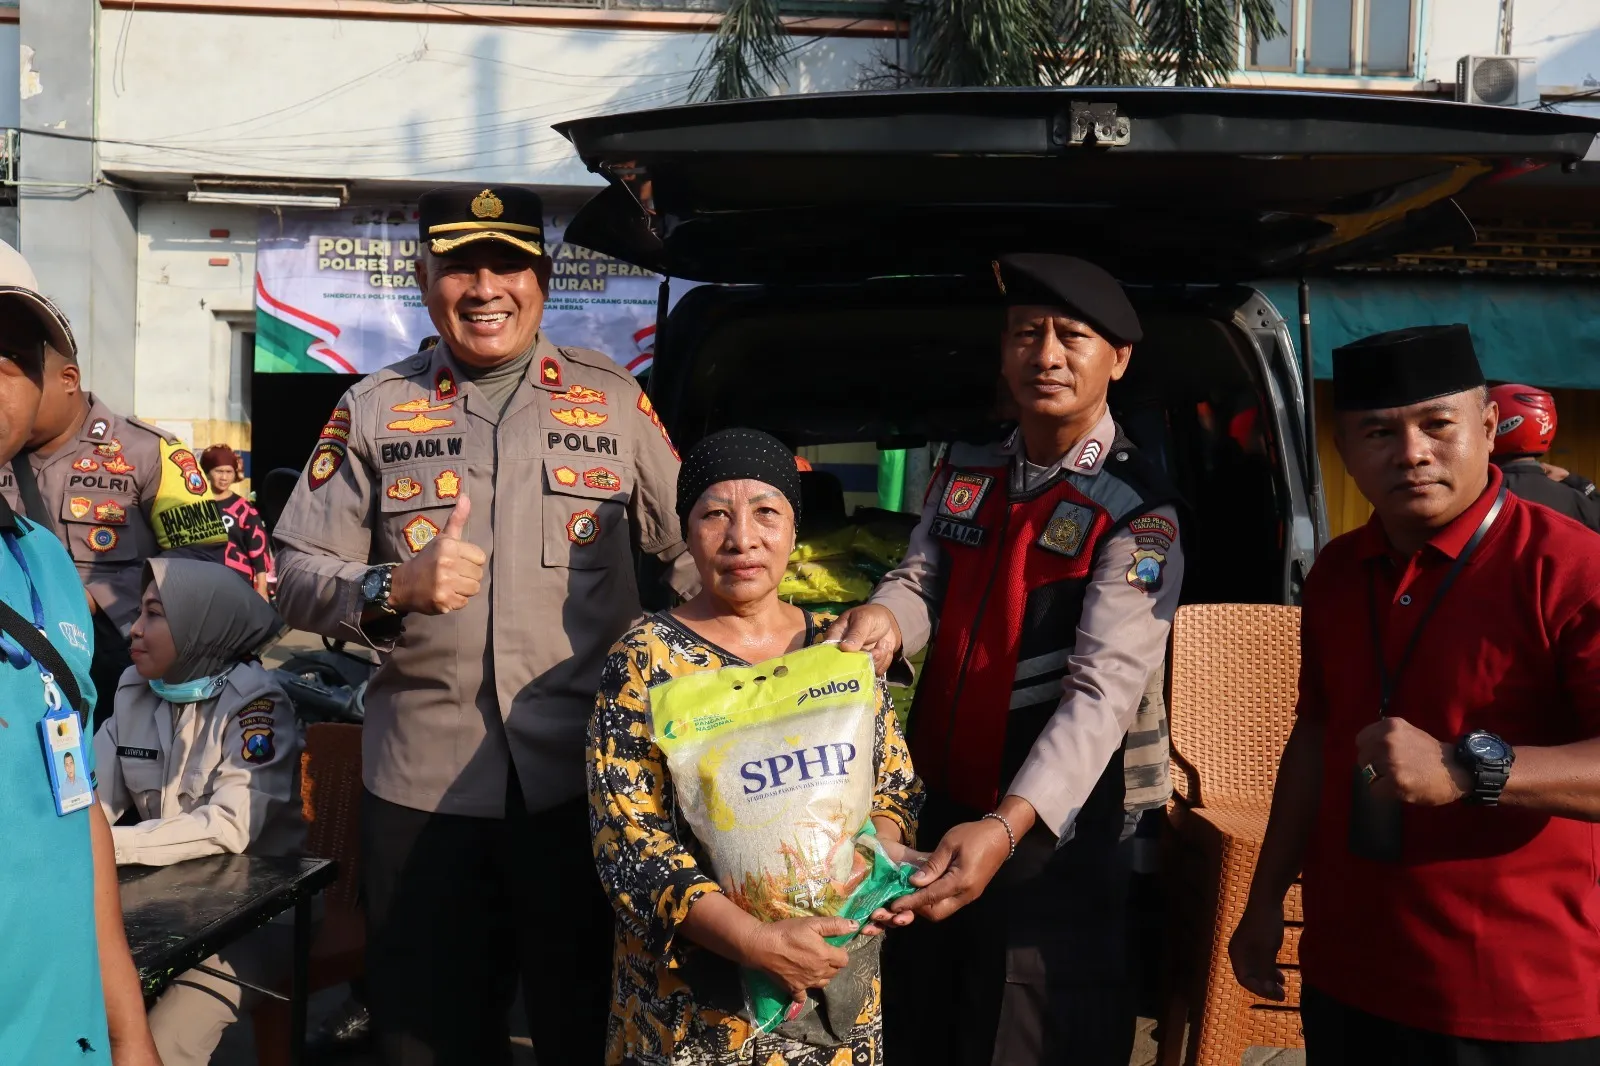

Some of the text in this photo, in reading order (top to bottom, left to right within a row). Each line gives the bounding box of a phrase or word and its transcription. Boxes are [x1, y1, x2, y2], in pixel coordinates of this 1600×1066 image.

[319, 238, 391, 256] POLRI
[320, 257, 388, 272] POLRES
[1497, 417, 1520, 434] NK
[381, 441, 412, 463] EKO
[447, 437, 462, 456] W
[547, 432, 618, 456] POLRI
[70, 475, 128, 492] POLRI
[932, 519, 983, 545] SALIM
[808, 679, 860, 698] bulog
[696, 719, 735, 731] NASIONAL
[740, 742, 856, 795] SPHP
[794, 892, 810, 909] 5
